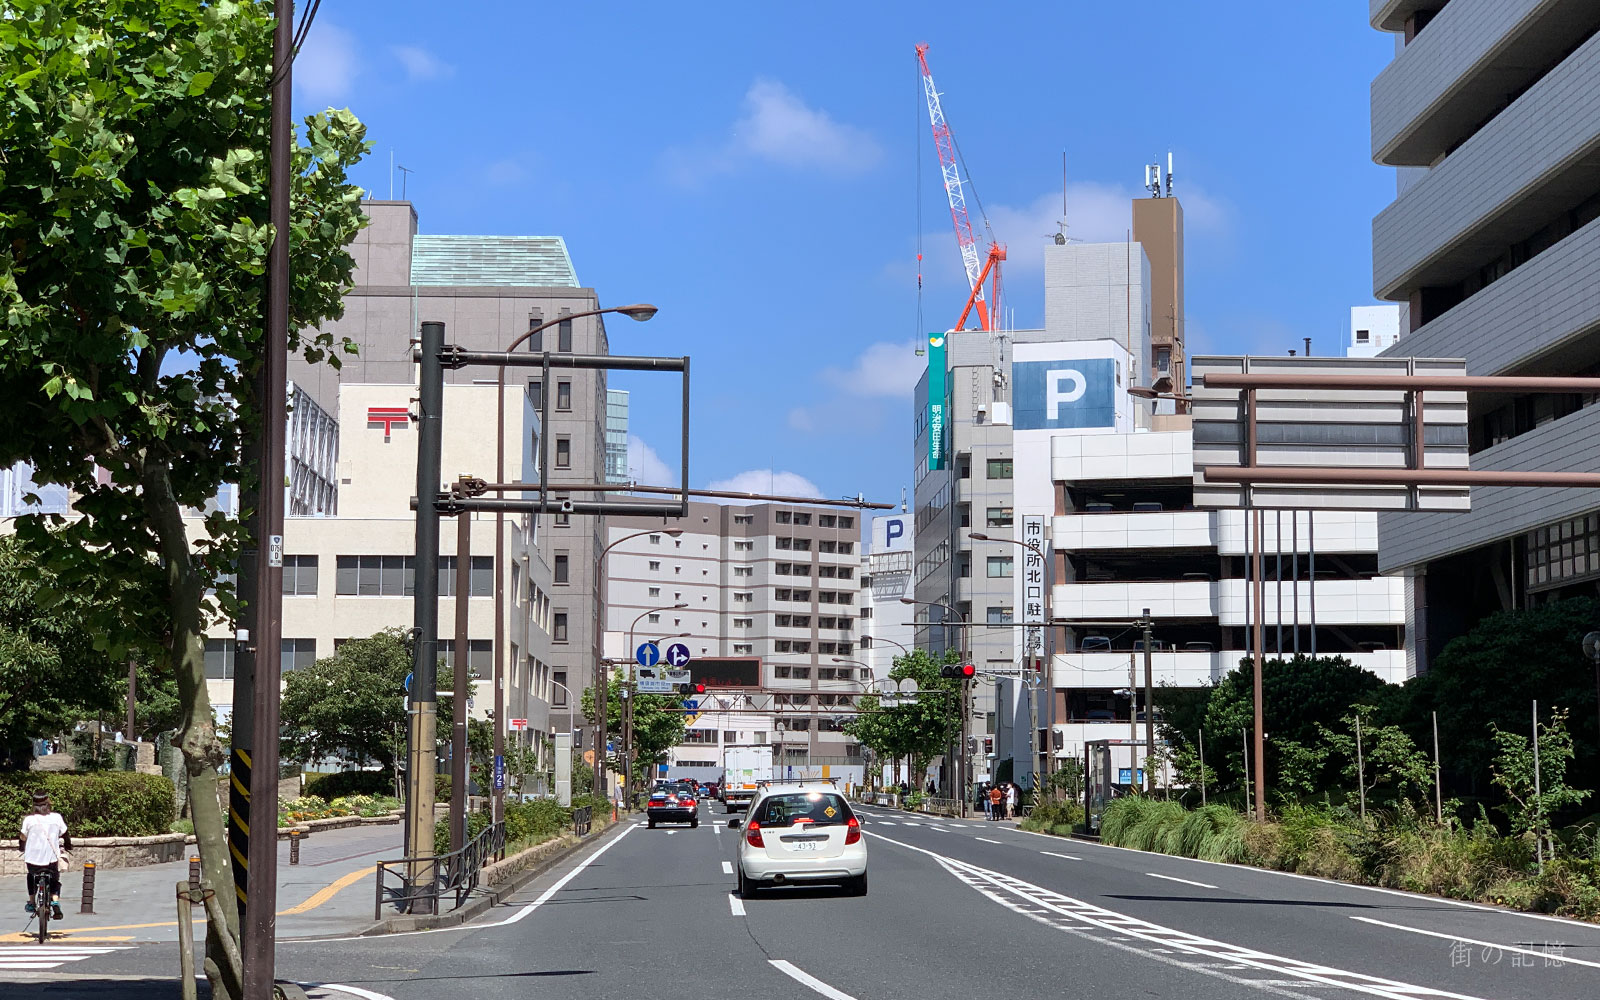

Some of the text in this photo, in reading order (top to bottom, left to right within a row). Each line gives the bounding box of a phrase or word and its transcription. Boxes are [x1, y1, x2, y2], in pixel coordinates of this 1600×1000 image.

[1046, 369, 1087, 420] P
[931, 404, 942, 459] 明治安田生命
[887, 519, 904, 547] P
